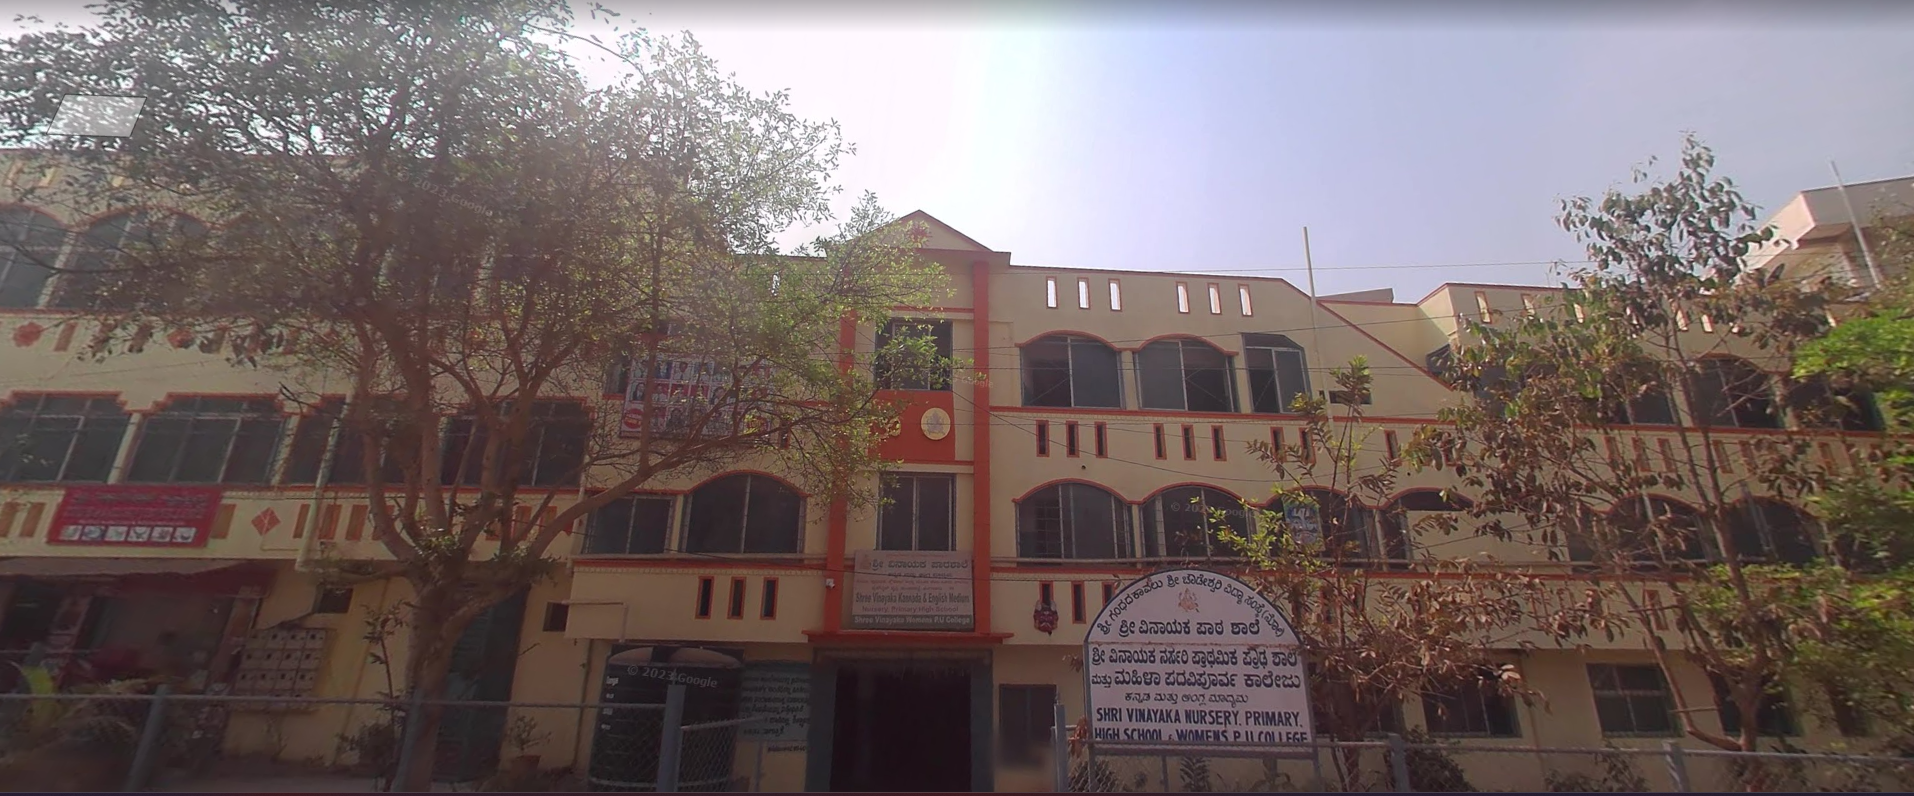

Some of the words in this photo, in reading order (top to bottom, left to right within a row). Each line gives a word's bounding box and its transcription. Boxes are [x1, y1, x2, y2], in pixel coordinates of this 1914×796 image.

[928, 592, 948, 605] English
[1097, 620, 1112, 635] ಶ್ರೀ
[1167, 574, 1180, 588] ಶ್ರೀ
[1119, 619, 1136, 637] ಶ್ರೀ
[1139, 618, 1191, 635] ವಿನಾಯಕ
[1230, 618, 1260, 635] ಶಾಲೆ
[1091, 647, 1105, 665] ಶ್ರೀ
[1108, 647, 1156, 664] ವಿನಾಯಕ
[1091, 673, 1112, 688] ಮತ್ತು
[1114, 668, 1161, 686] ಮಹಿಳಾ
[1243, 670, 1301, 688] ಕಾಲೇಜು
[1125, 692, 1151, 703] ಕನ್ನಡ
[1154, 692, 1178, 705] ಮತ್ತು
[1096, 707, 1122, 722] SHRI
[1126, 708, 1181, 724] VINAYAKA
[1094, 727, 1120, 740] HIGH
